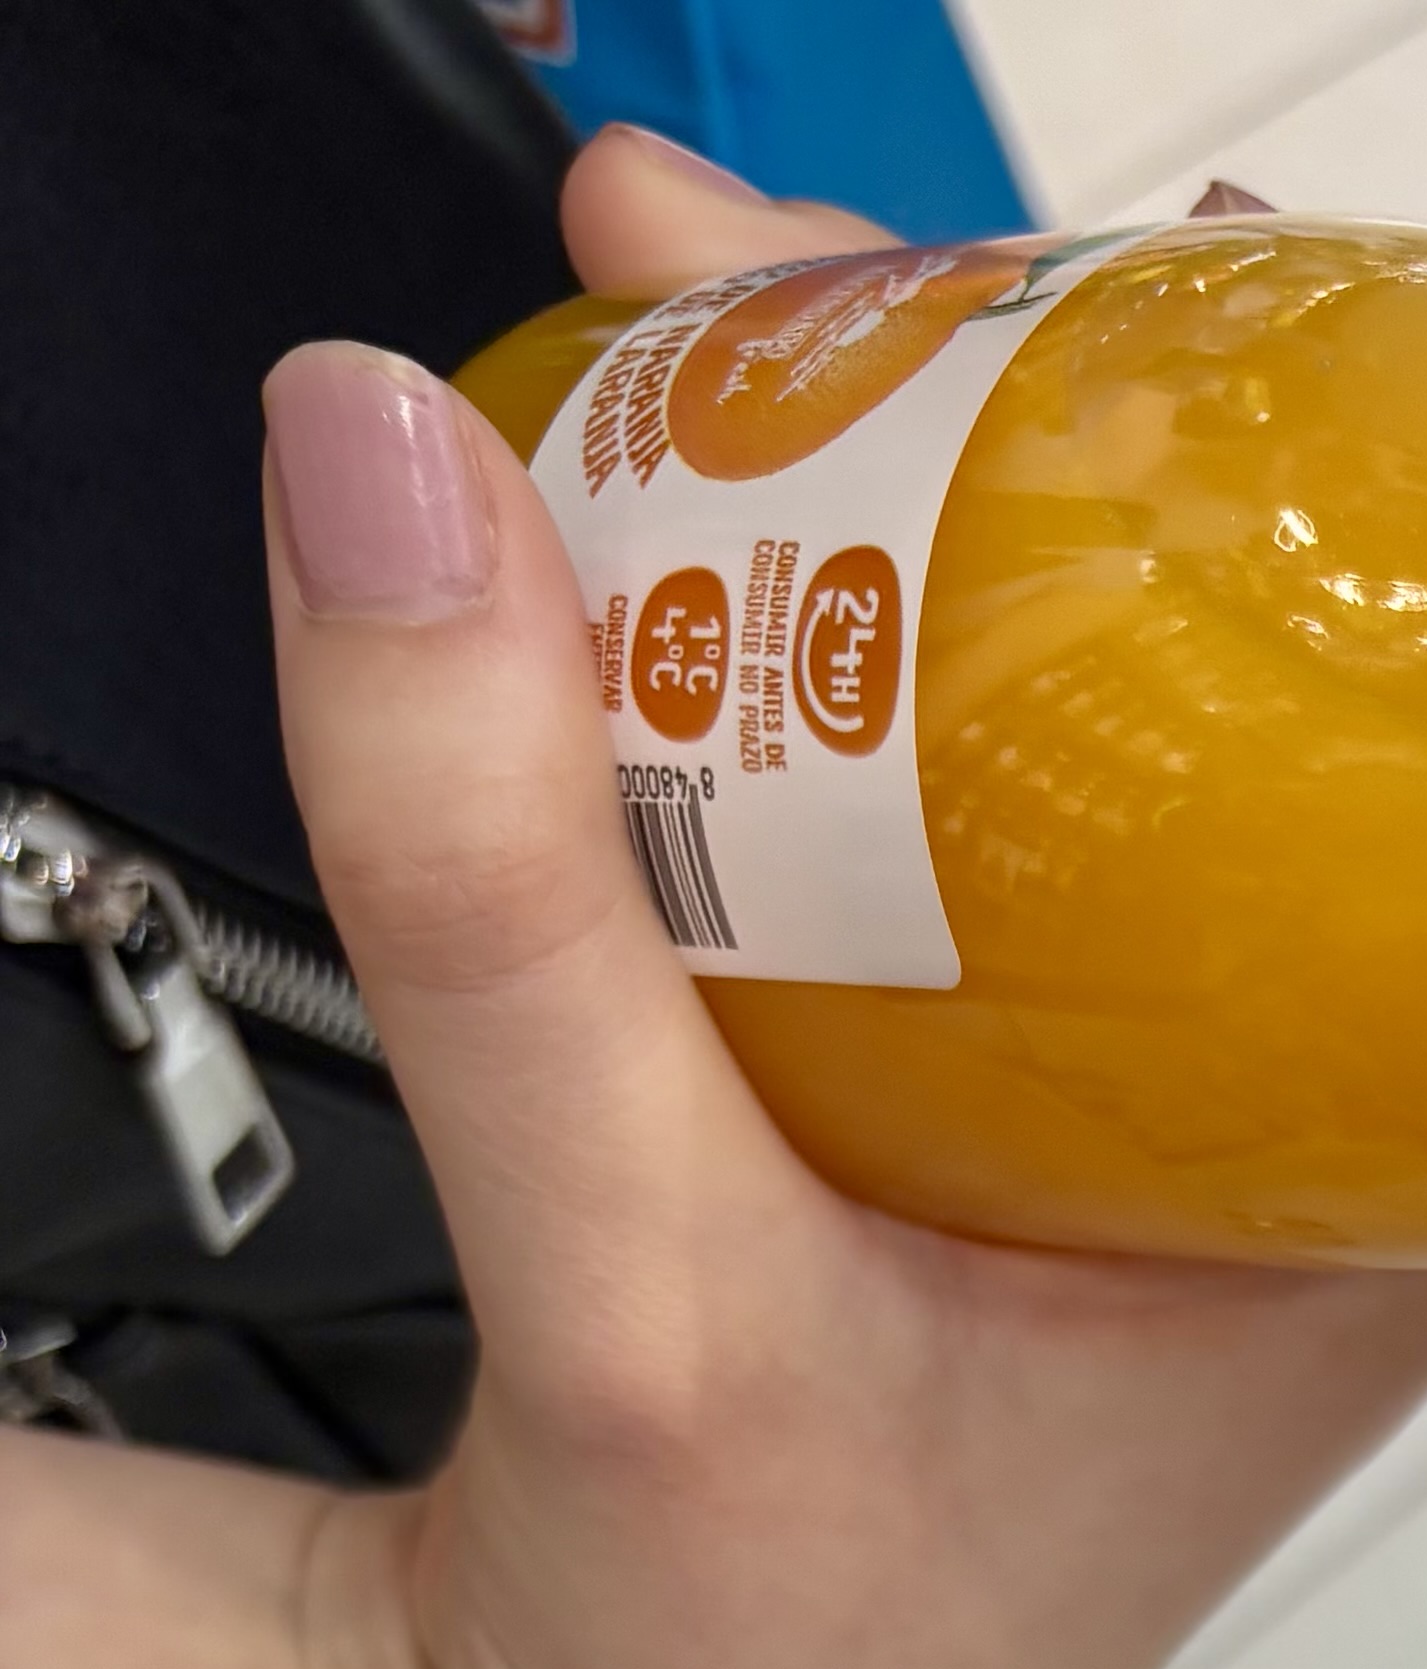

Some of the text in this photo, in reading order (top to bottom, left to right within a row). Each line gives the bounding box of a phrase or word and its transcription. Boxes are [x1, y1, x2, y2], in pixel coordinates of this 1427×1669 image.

[738, 538, 776, 775] CONSUMIR NO PRAZO
[762, 539, 801, 773] CONSUMIR ANTES DE
[829, 588, 880, 704] 24H
